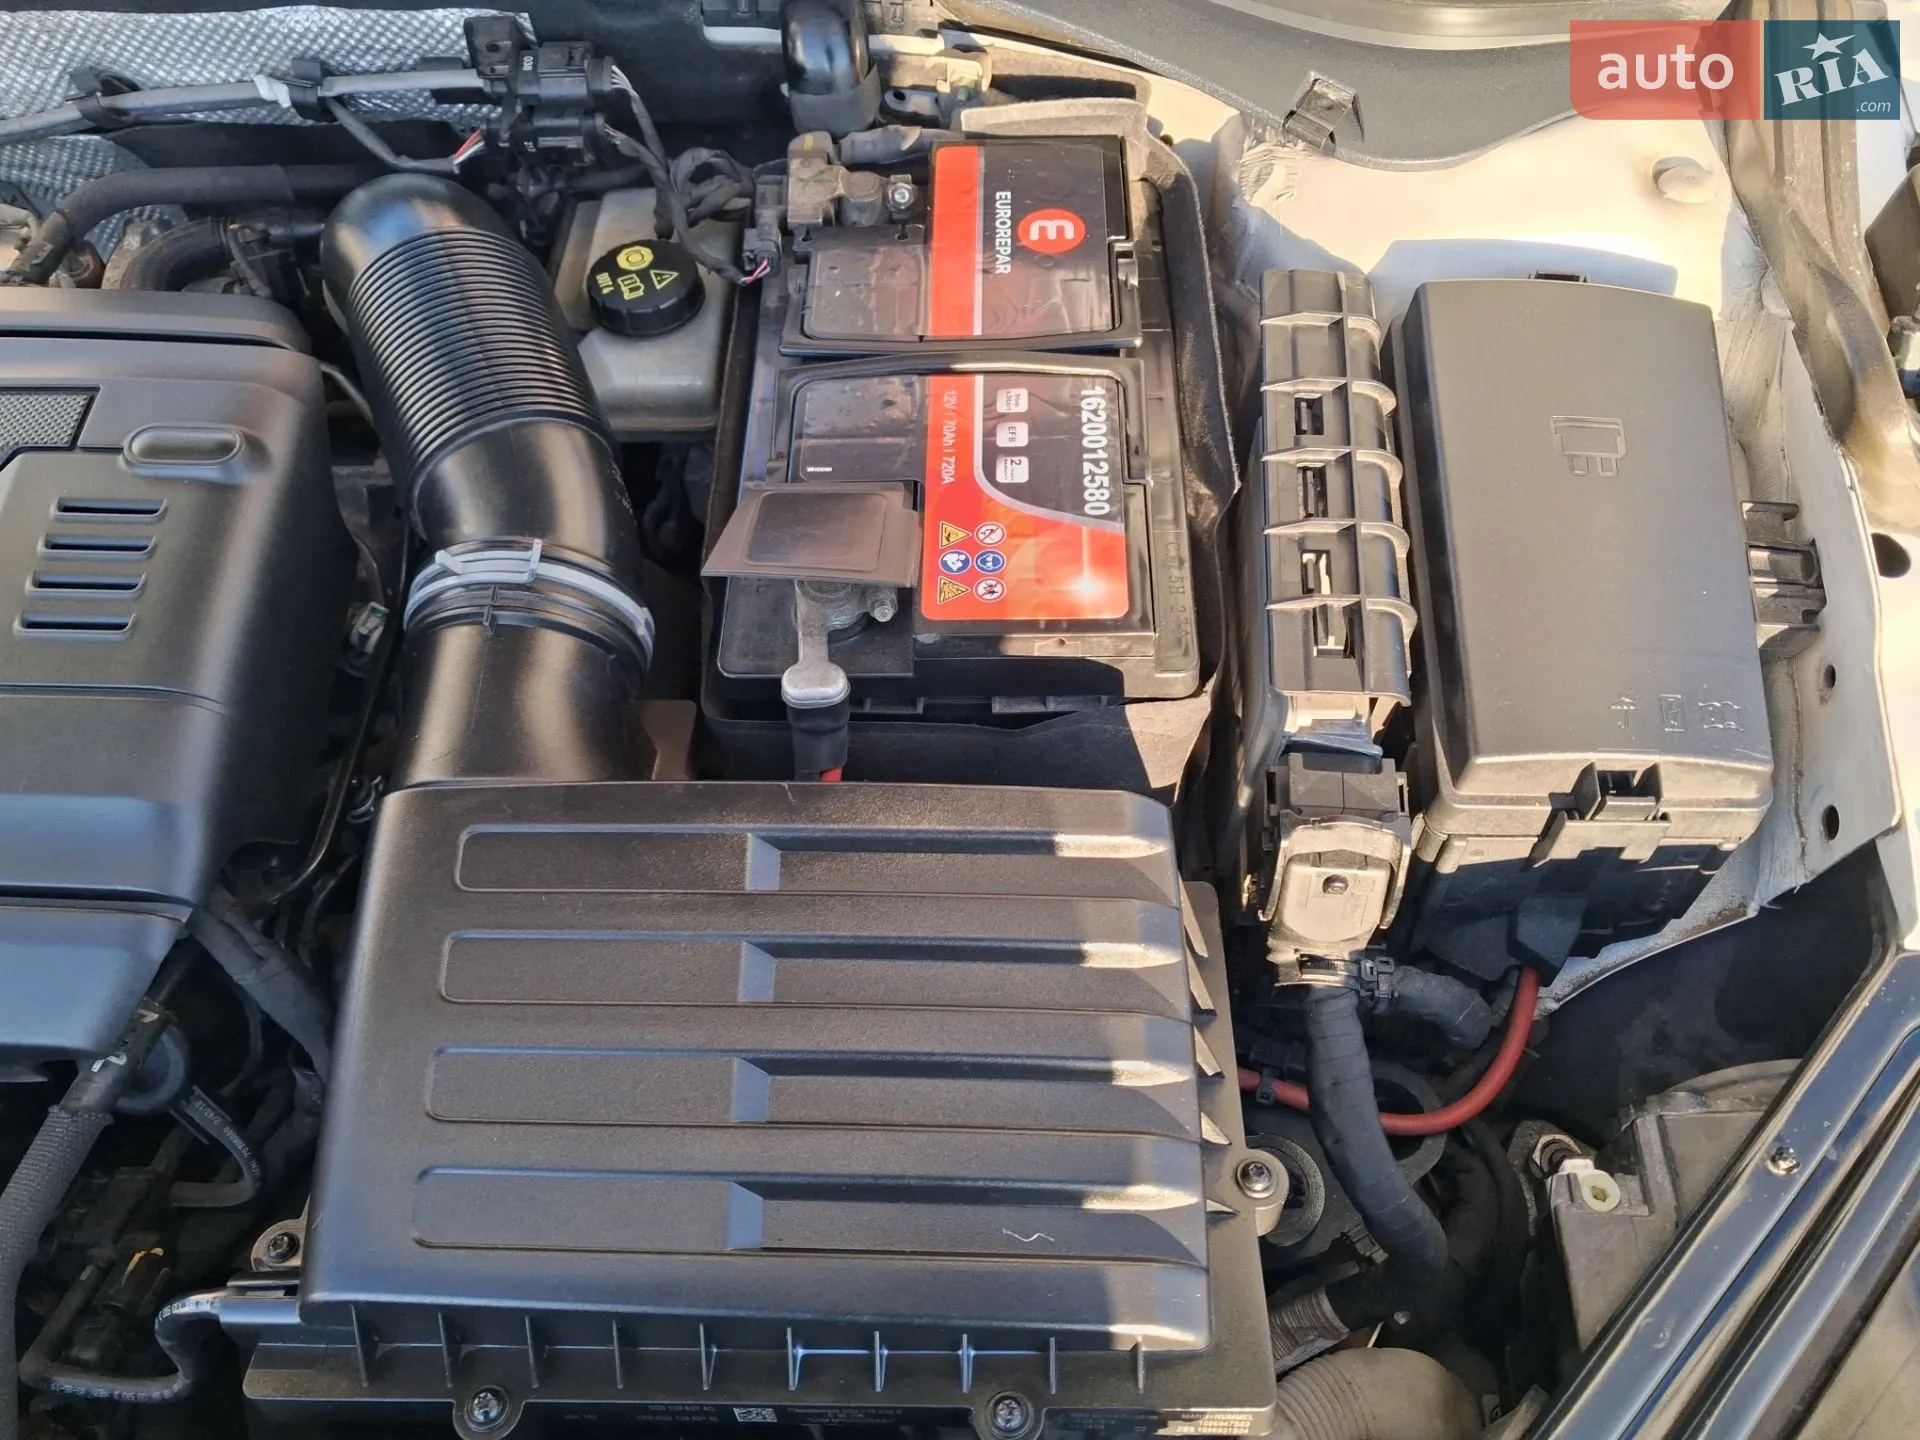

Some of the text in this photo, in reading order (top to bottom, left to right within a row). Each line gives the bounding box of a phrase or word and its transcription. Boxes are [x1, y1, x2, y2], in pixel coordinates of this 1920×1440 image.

[995, 191, 1012, 274] EUROREPAR
[943, 390, 957, 409] 12V
[942, 419, 957, 446] 70Ah
[1008, 426, 1017, 442] EFB
[1010, 458, 1022, 466] 2
[1080, 386, 1111, 516] 1620012580
[941, 456, 956, 485] 720A
